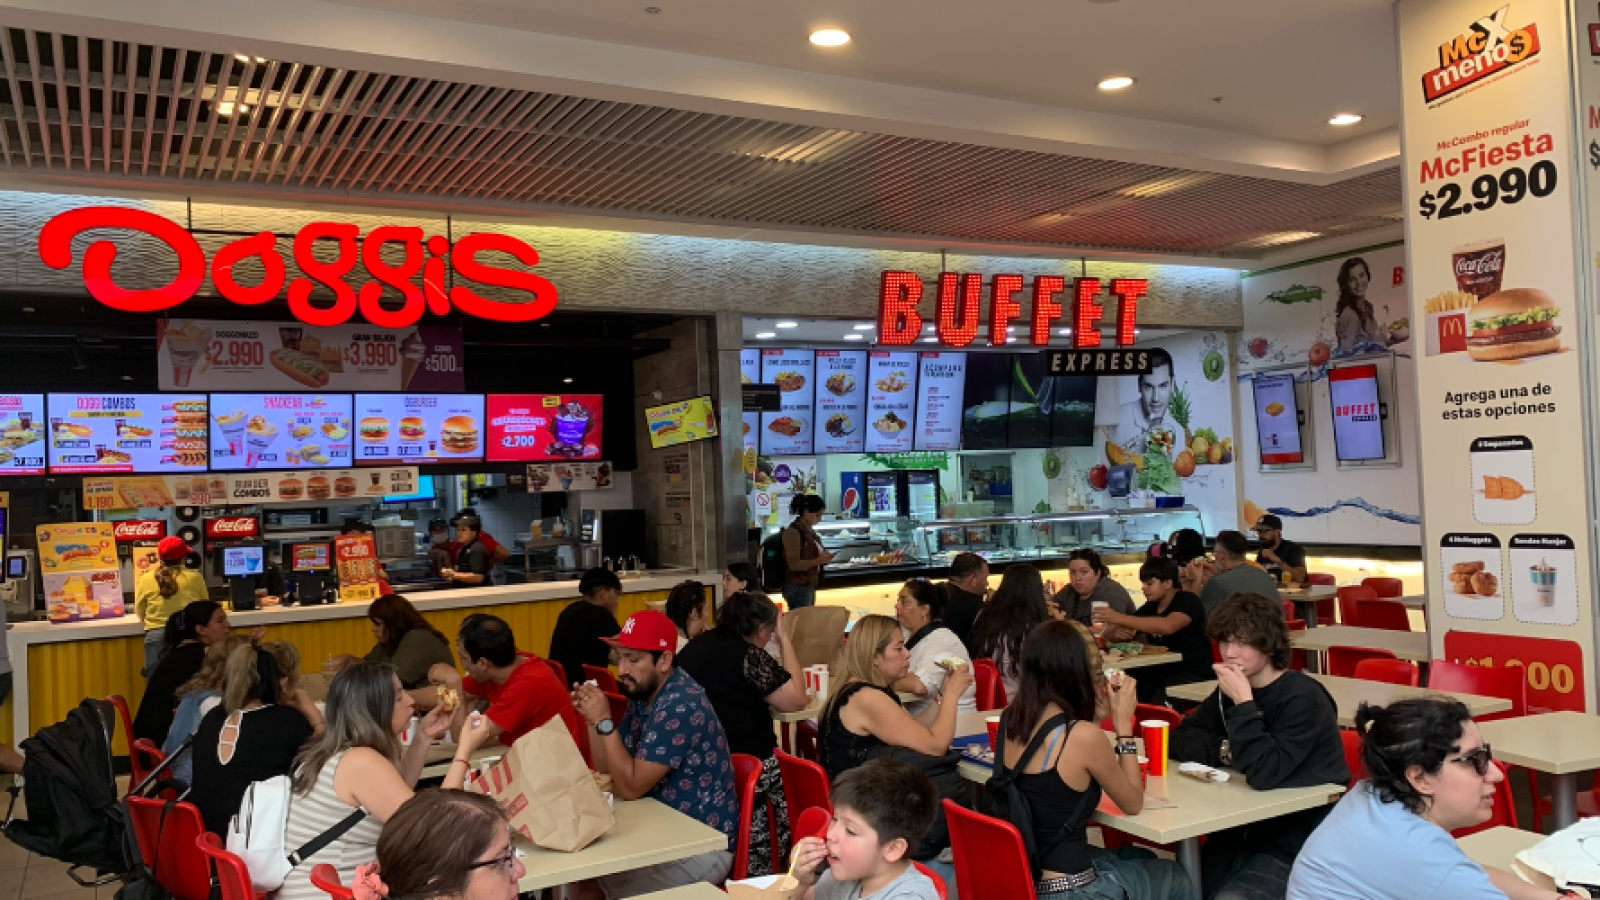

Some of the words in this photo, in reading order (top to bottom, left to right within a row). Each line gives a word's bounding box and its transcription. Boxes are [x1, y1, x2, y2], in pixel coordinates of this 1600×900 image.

[1436, 128, 1490, 152] McCombo
[1491, 117, 1531, 138] regular
[1419, 132, 1554, 184] McFiesta
[1419, 159, 1558, 220] $2.990
[878, 270, 1150, 348] BUFFET
[204, 341, 264, 366] $2.990
[343, 341, 397, 367] $3.990
[425, 354, 457, 372] $500
[1051, 352, 1150, 373] EXPRESS
[1443, 391, 1496, 406] Agrega
[1499, 386, 1529, 399] una
[1532, 382, 1552, 396] de
[1335, 403, 1376, 417] BUFFET
[1442, 407, 1482, 421] estas
[1485, 401, 1556, 420] opciones
[233, 487, 271, 498] COMBOS
[235, 478, 269, 490] BURGER
